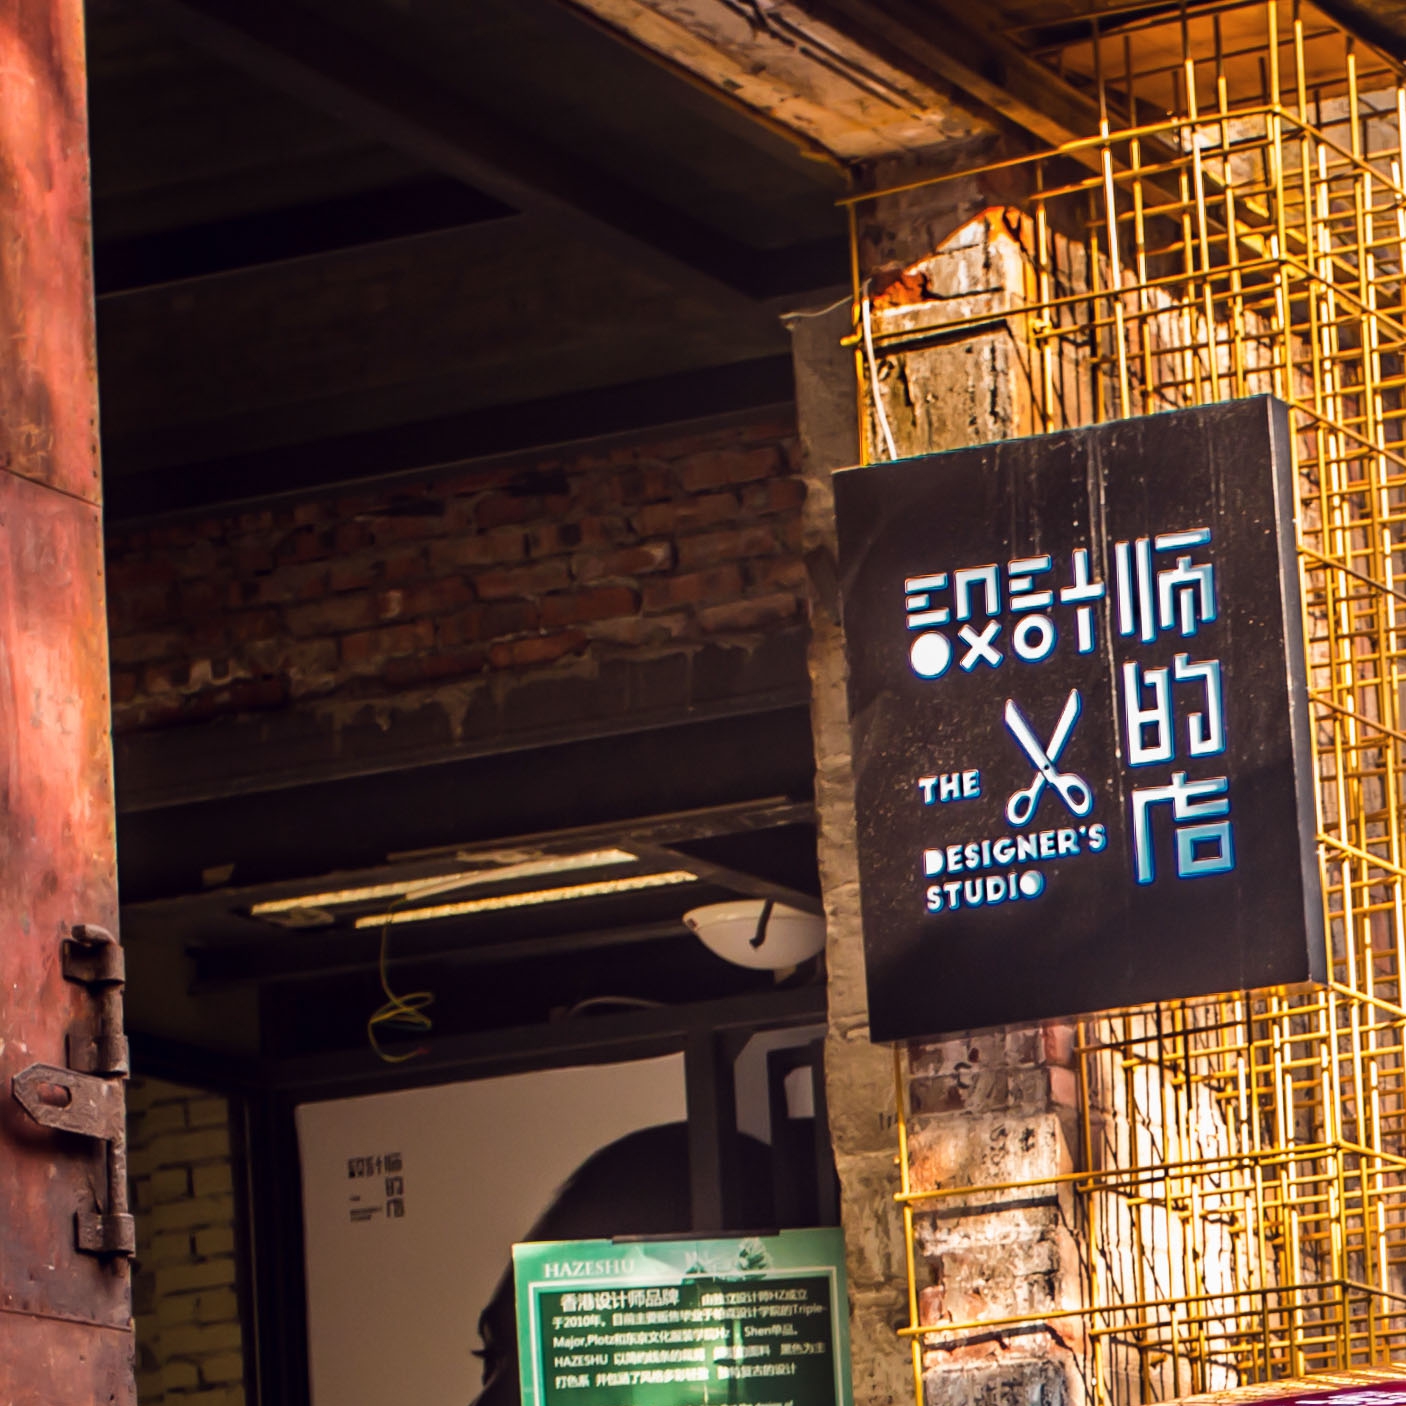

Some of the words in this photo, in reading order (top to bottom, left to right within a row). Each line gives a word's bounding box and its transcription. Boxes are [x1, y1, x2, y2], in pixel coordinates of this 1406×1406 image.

[918, 769, 982, 804] THE
[923, 824, 1108, 878] DESIGNER'S
[925, 870, 1046, 913] STUDIO
[544, 1258, 634, 1278] HAZESHU
[555, 1353, 609, 1368] HAZESHU
